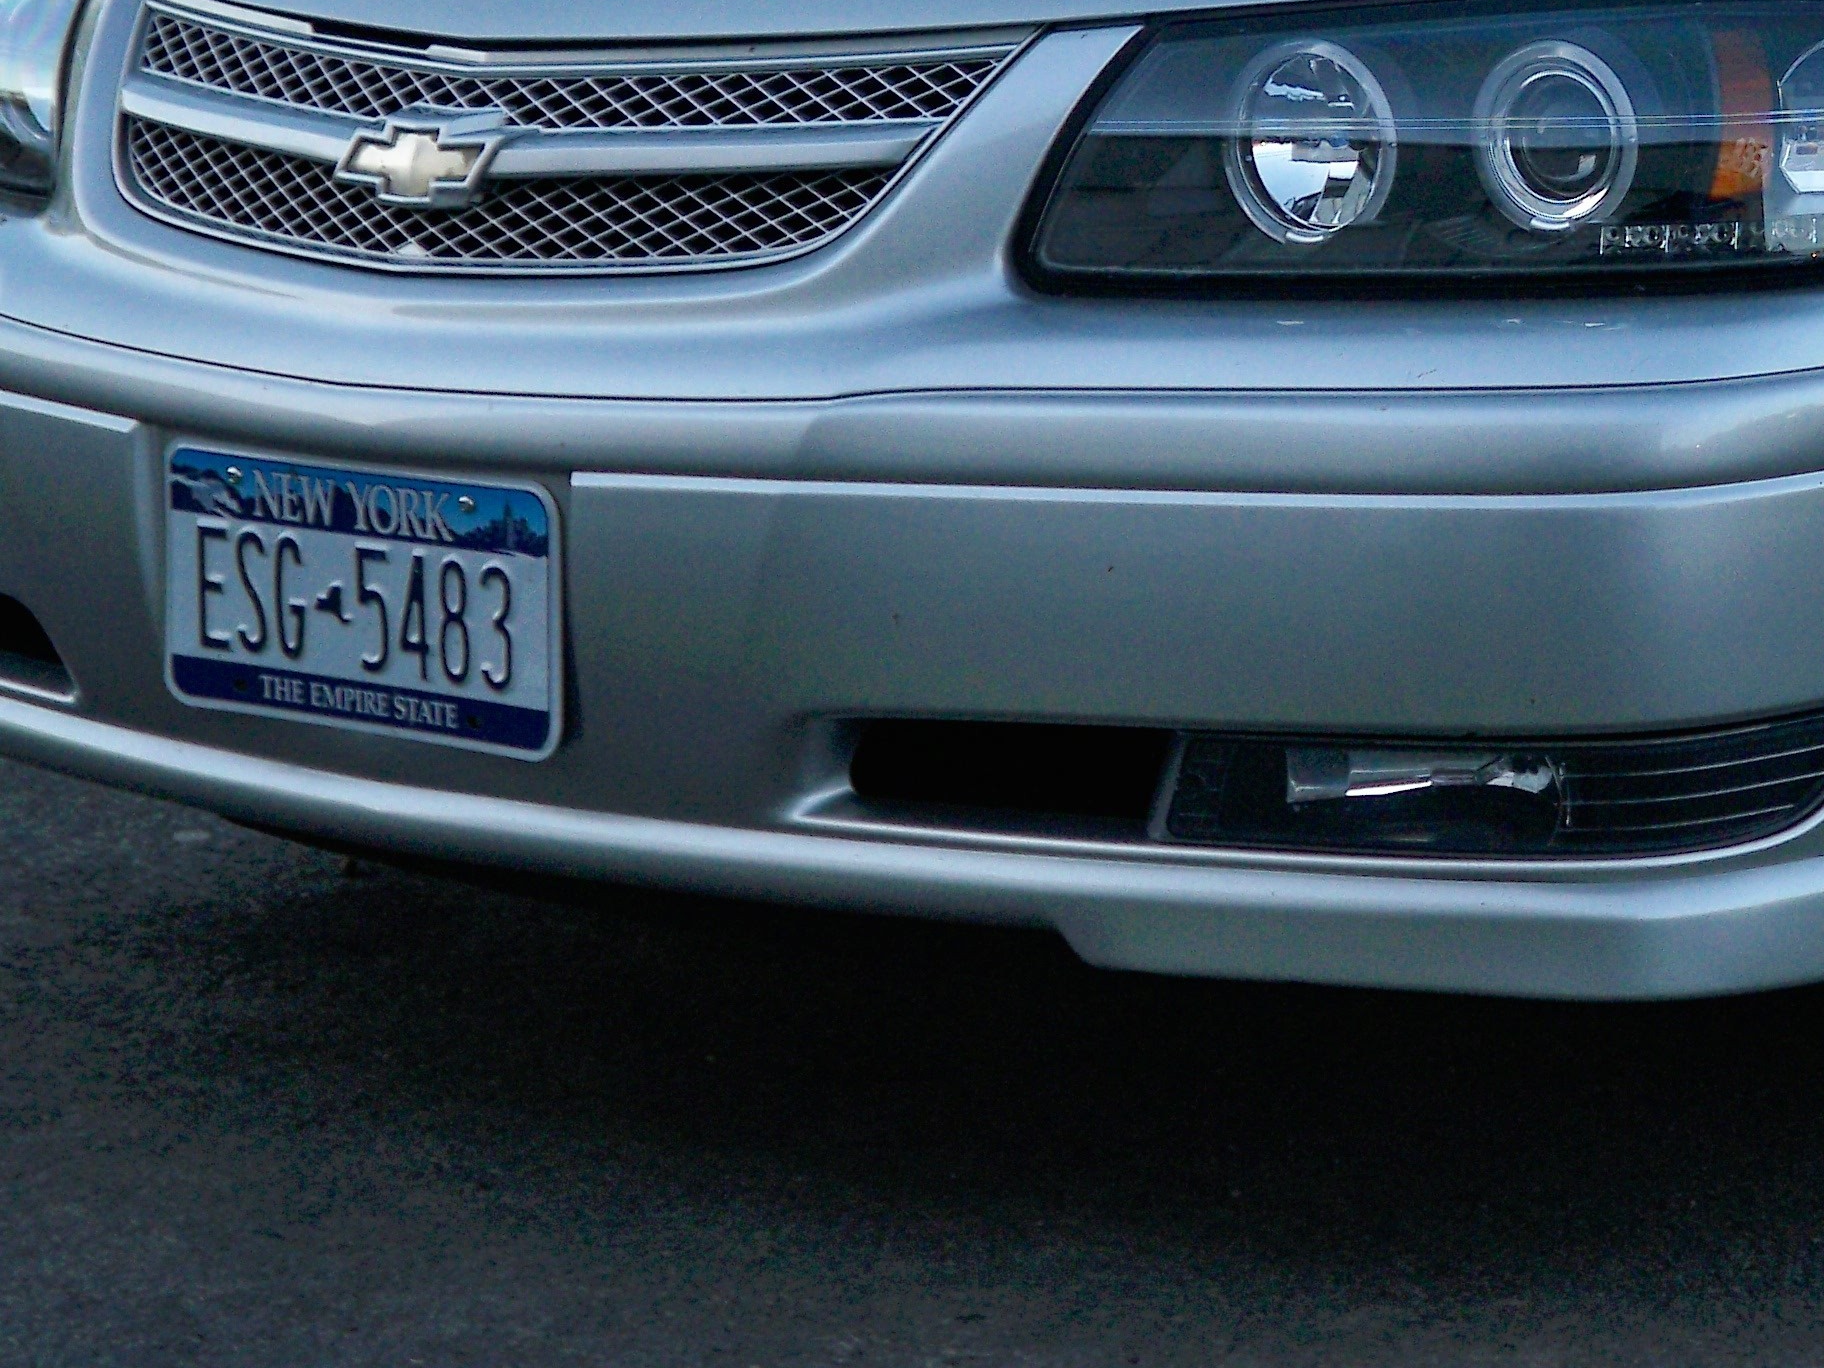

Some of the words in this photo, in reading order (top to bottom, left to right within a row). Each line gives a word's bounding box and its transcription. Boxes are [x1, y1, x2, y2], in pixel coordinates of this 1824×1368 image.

[252, 469, 337, 528] NEW
[347, 481, 455, 543] YORK
[197, 516, 307, 659] ESG
[354, 540, 513, 691] 5483
[259, 675, 303, 702] THE
[310, 683, 390, 719] EMPIRE
[394, 696, 459, 730] STATE
